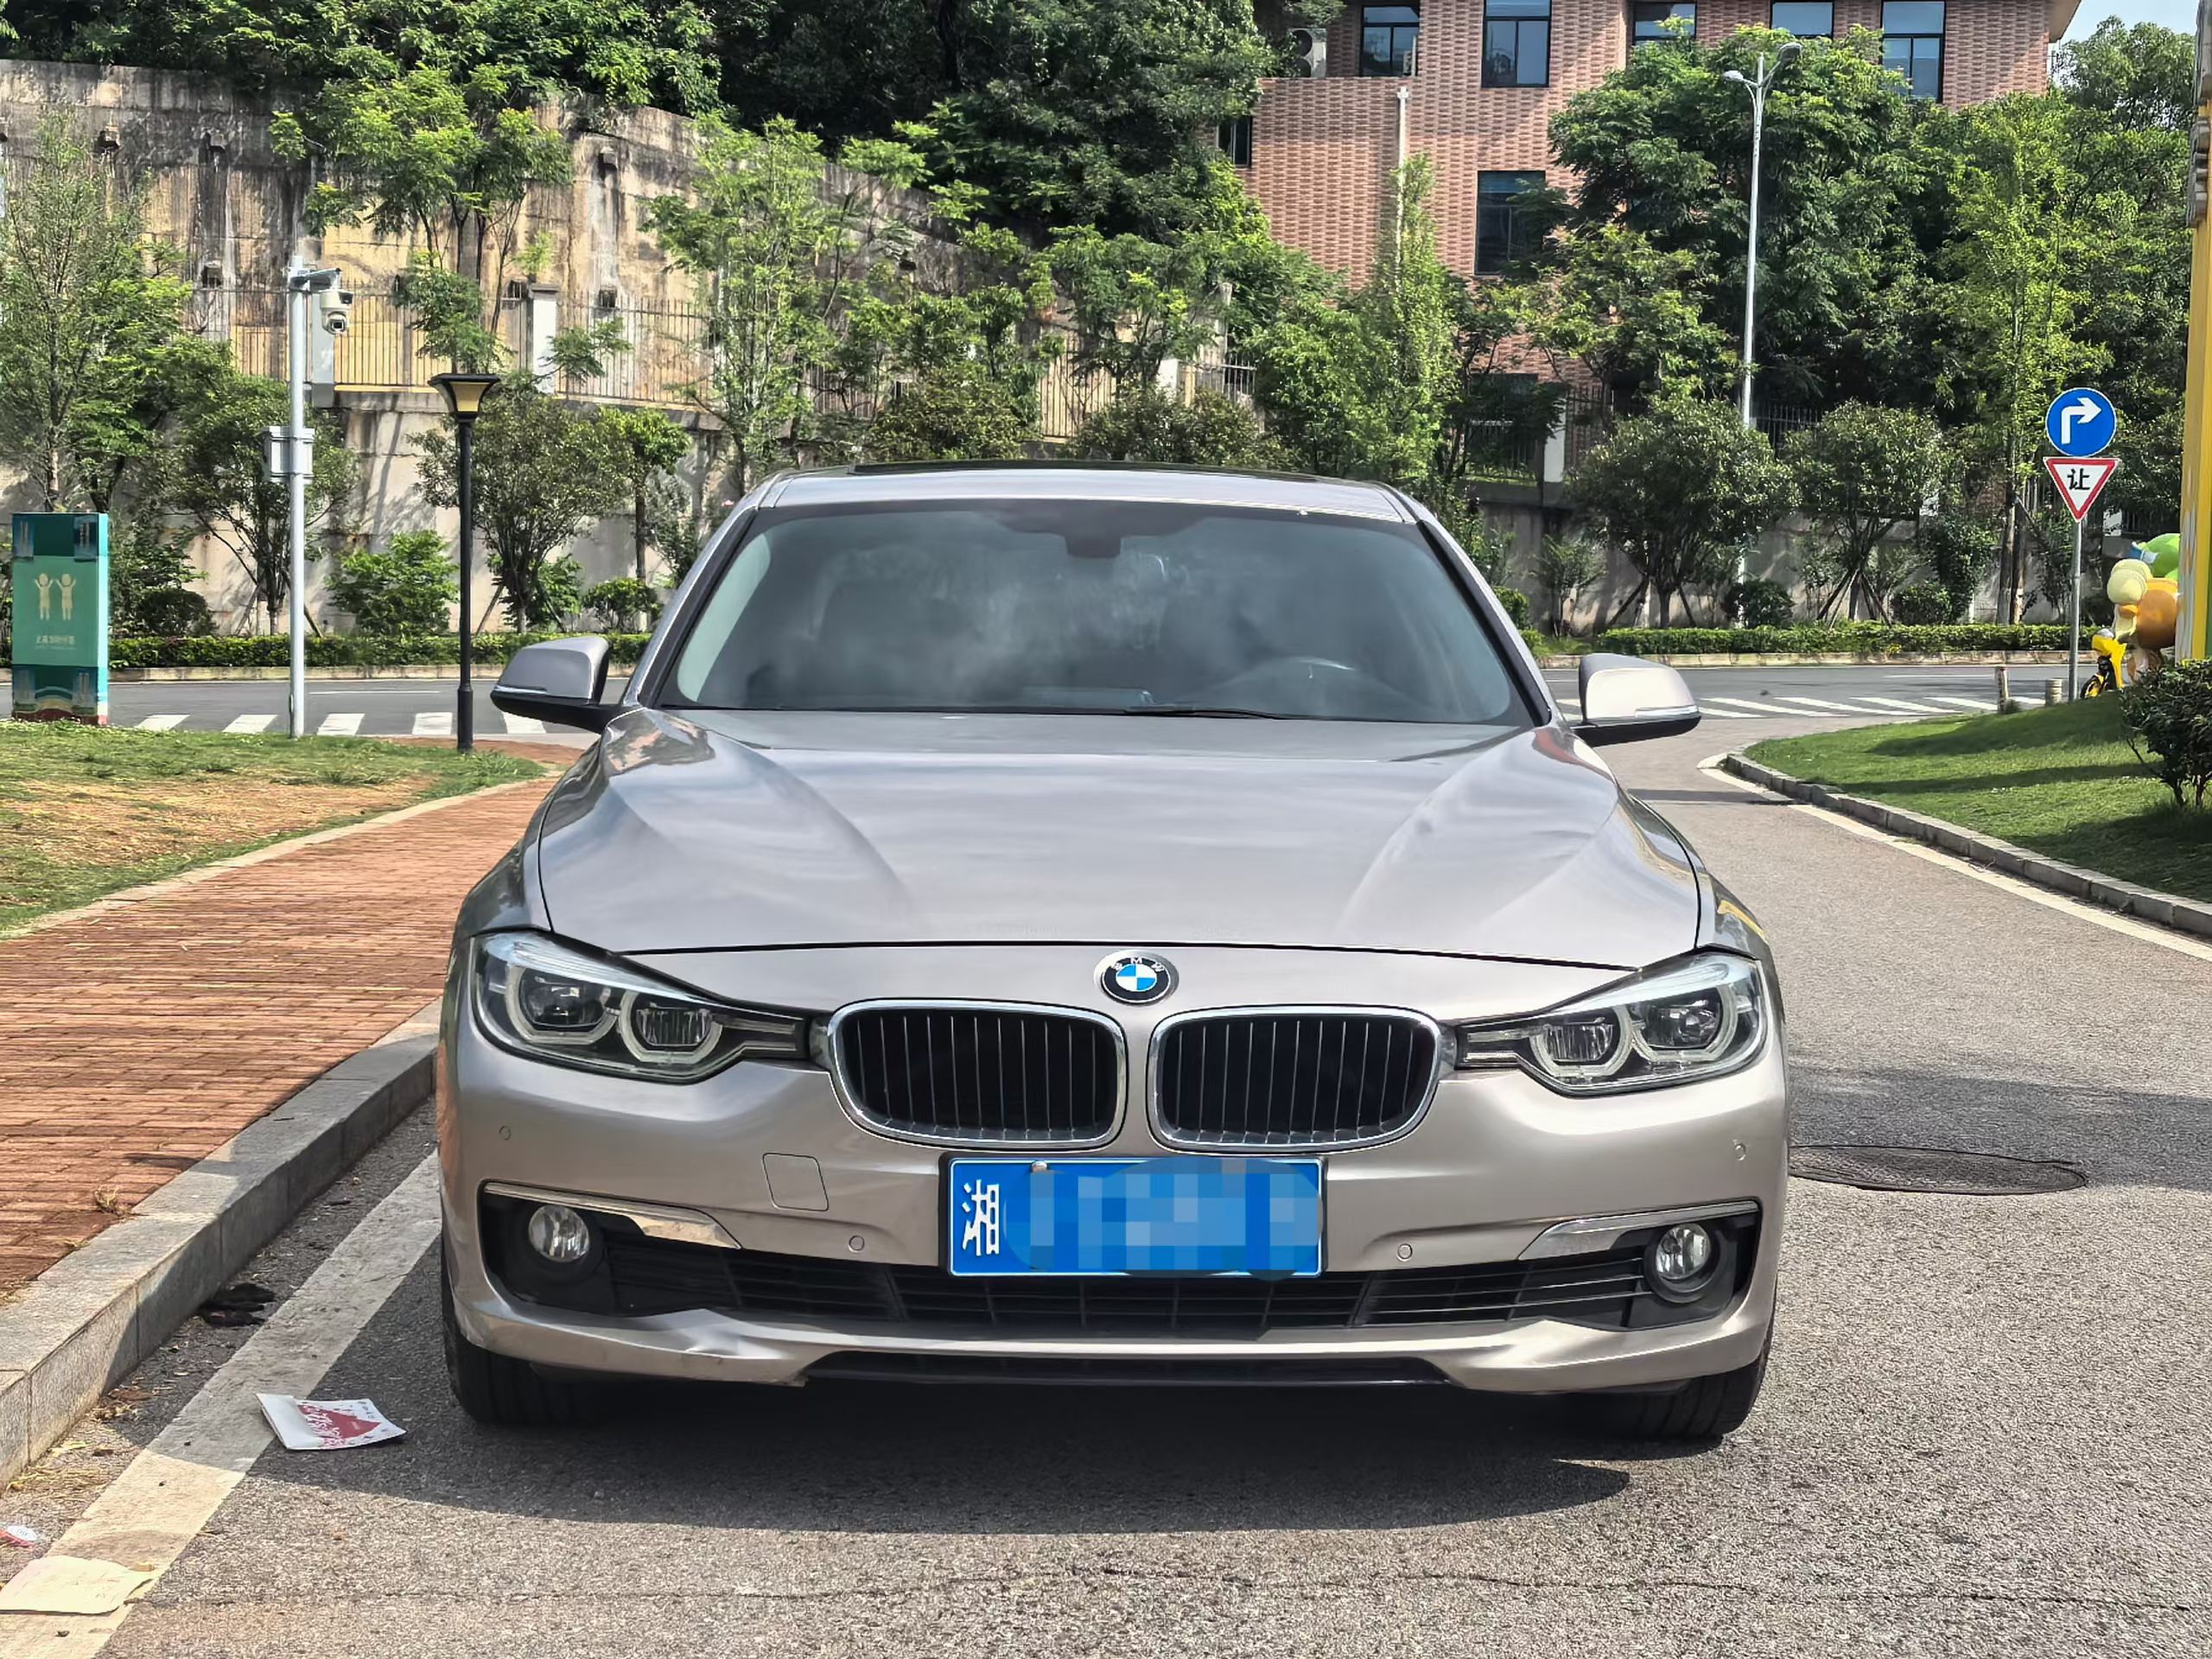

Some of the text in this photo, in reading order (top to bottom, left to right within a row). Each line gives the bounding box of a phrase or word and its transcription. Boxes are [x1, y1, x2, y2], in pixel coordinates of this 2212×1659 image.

[2068, 468, 2090, 490] 让
[1114, 957, 1165, 972] BMW
[962, 1179, 1000, 1256] 湘
